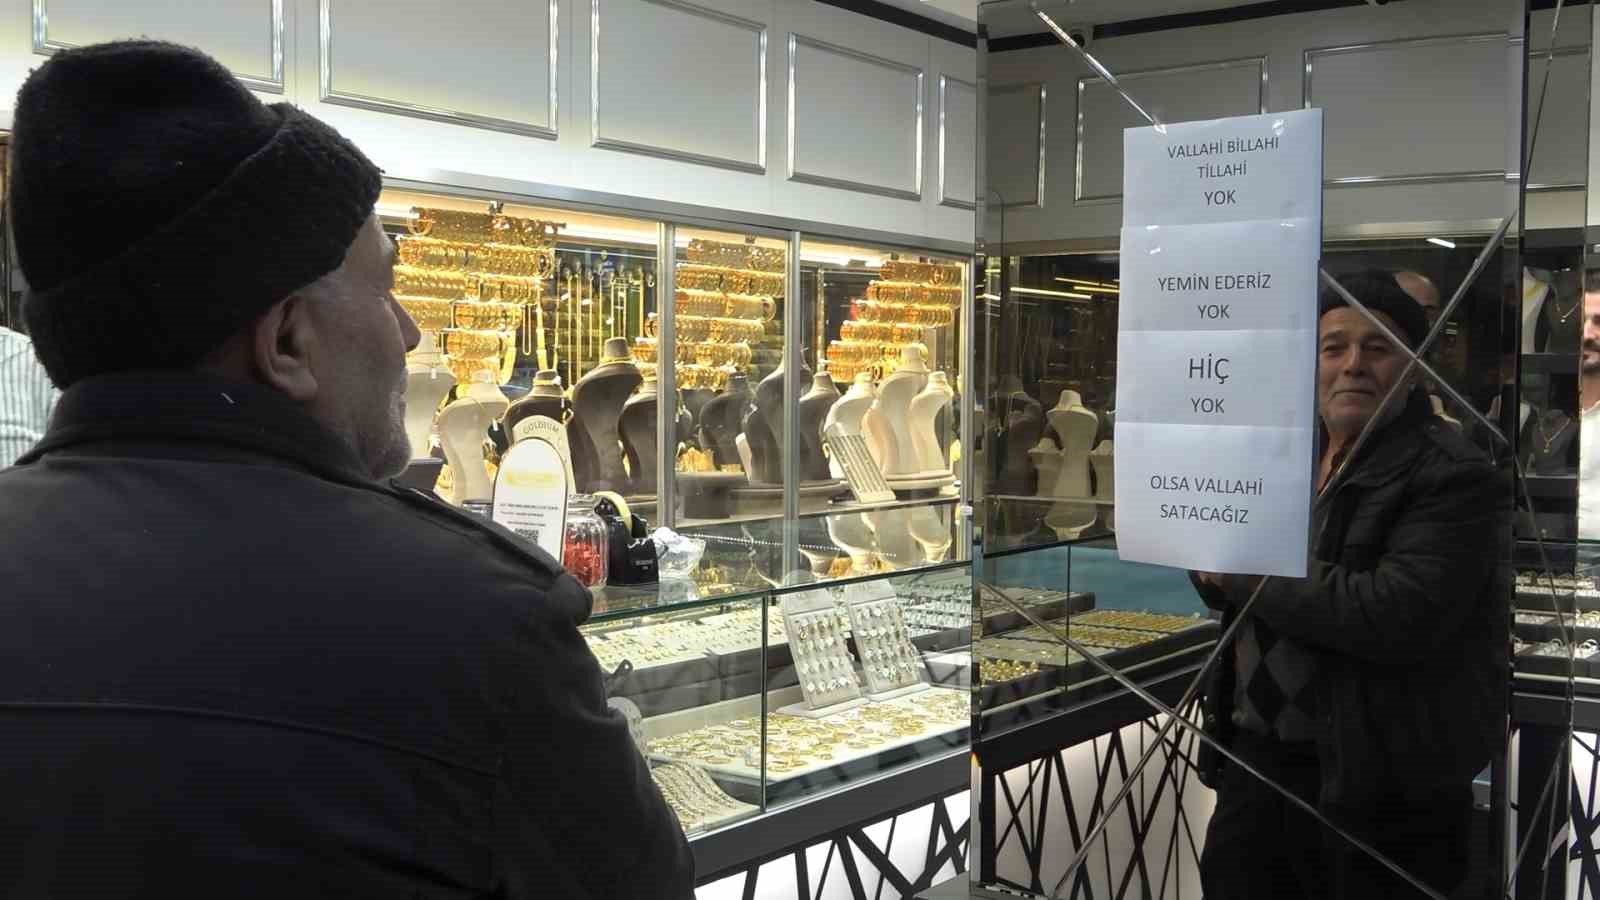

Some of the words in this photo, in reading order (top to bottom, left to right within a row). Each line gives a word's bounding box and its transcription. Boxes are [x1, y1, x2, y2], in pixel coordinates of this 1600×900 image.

[1167, 138, 1224, 159] VALLAHİ
[1197, 160, 1247, 178] TİLLAHİ
[1204, 189, 1237, 206] YOK
[1157, 273, 1210, 292] YEMİN
[1214, 272, 1272, 290] EDERİZ
[1197, 304, 1231, 320] YOK
[1188, 353, 1230, 384] HİÇ
[1190, 396, 1226, 414] YOK
[1149, 474, 1190, 491] OLSA
[1193, 477, 1264, 496] VALLAHİ
[1159, 503, 1249, 524] SATACAĞIZ
